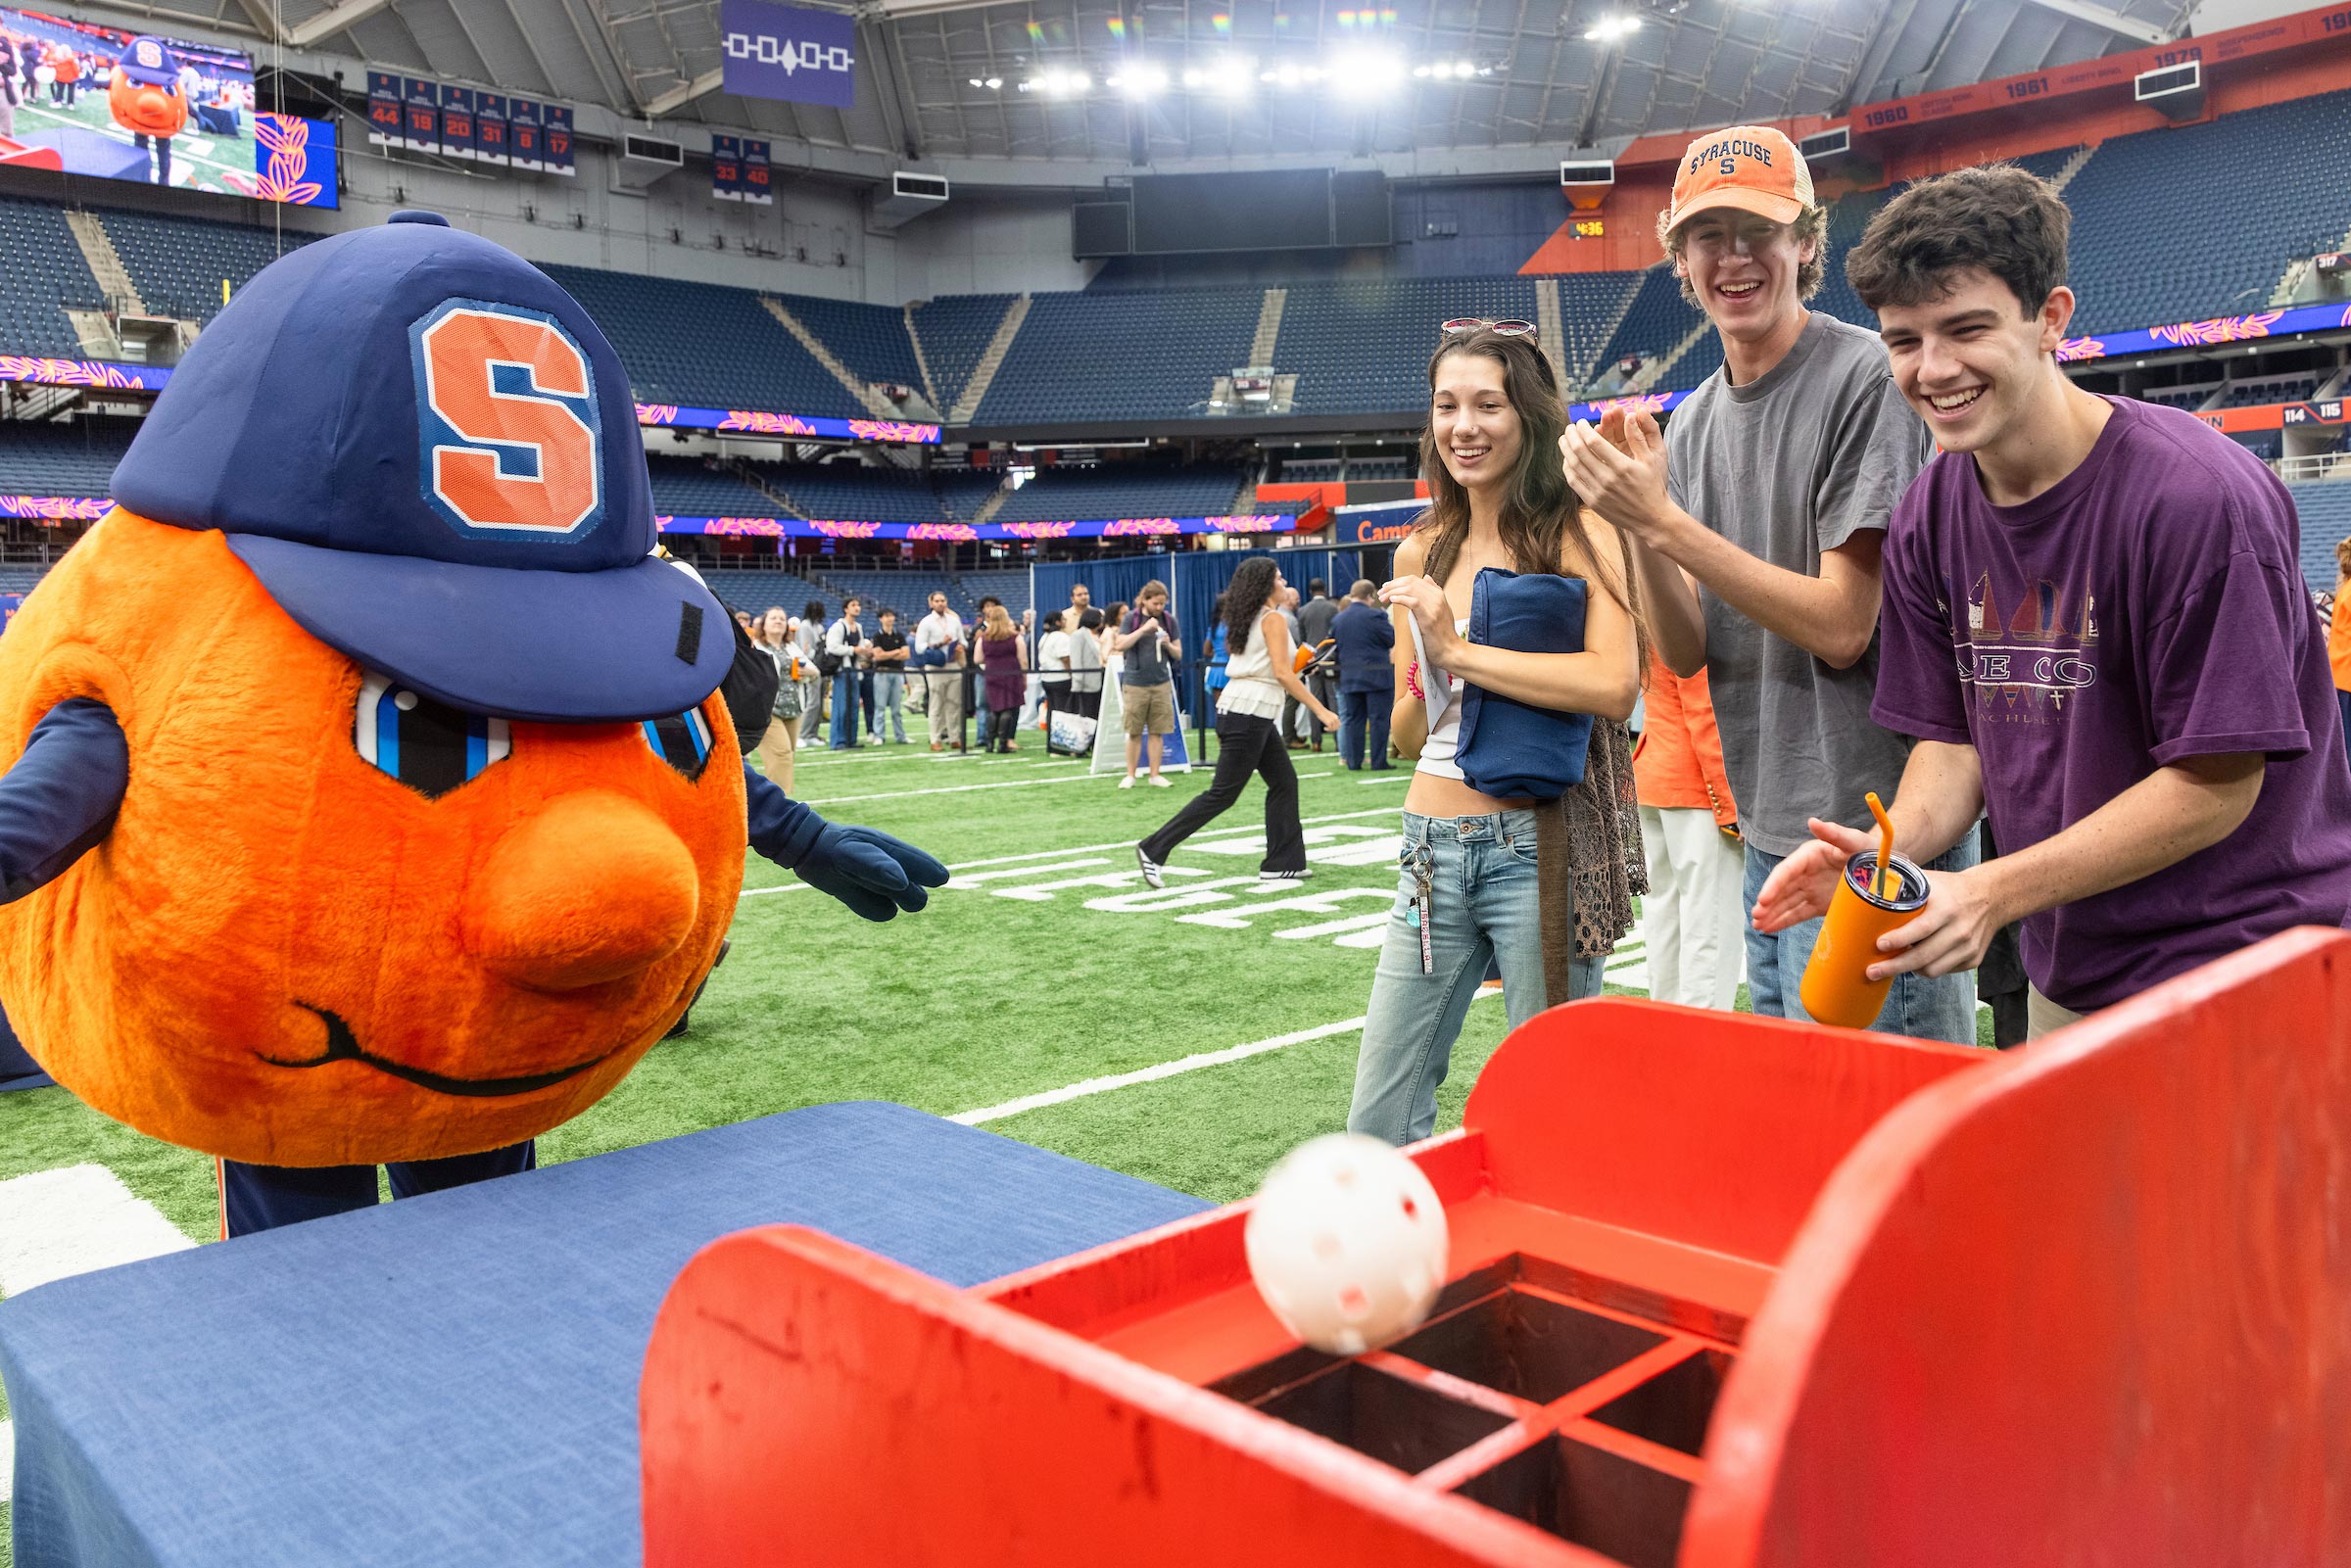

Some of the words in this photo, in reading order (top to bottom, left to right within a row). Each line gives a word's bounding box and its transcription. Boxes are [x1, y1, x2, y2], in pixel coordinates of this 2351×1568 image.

[2155, 47, 2202, 69] 1979
[2005, 77, 2049, 99] 1961
[1864, 106, 1909, 127] 1960
[1691, 139, 1772, 175] SYRACUSE
[1720, 158, 1735, 174] S
[1575, 221, 1604, 236] 4:36
[2318, 256, 2338, 269] 317
[2284, 407, 2306, 423] 114
[2320, 402, 2341, 418] 115
[421, 308, 596, 534] S
[1357, 519, 1425, 544] Camp
